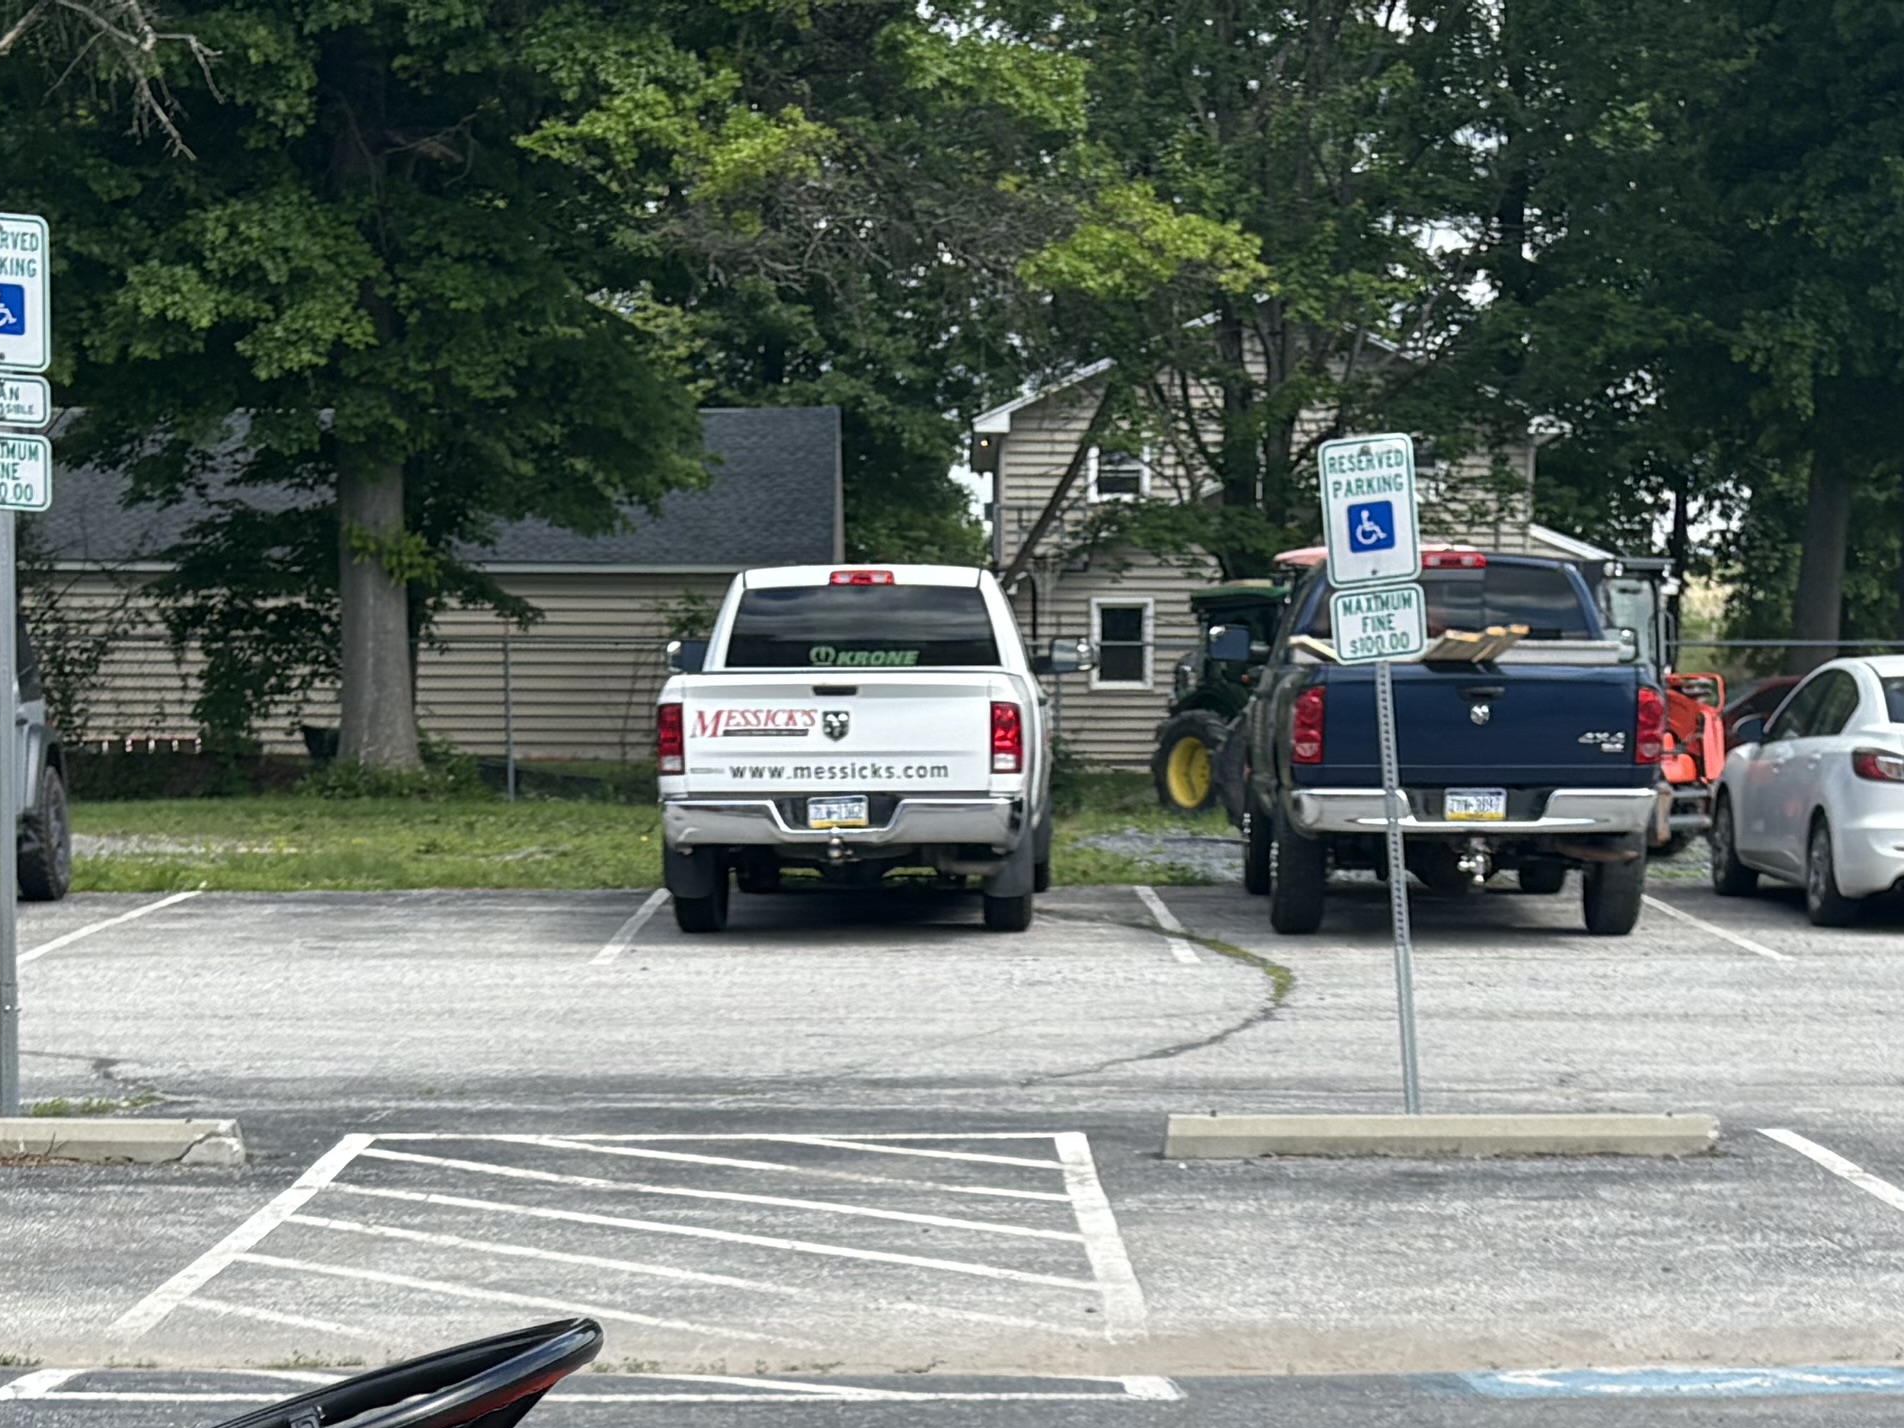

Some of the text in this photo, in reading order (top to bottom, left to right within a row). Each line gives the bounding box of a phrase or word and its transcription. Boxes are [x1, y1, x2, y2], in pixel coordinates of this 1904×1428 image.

[1328, 449, 1404, 474] RESERVED
[1333, 473, 1404, 498] PARKING
[1342, 592, 1412, 616] MAXIMUM
[1362, 613, 1396, 632] FINE
[1350, 632, 1410, 654] $100.00
[835, 650, 920, 666] KRONE
[692, 710, 816, 737] MESSICK'S
[729, 762, 949, 780] www.messicks.com
